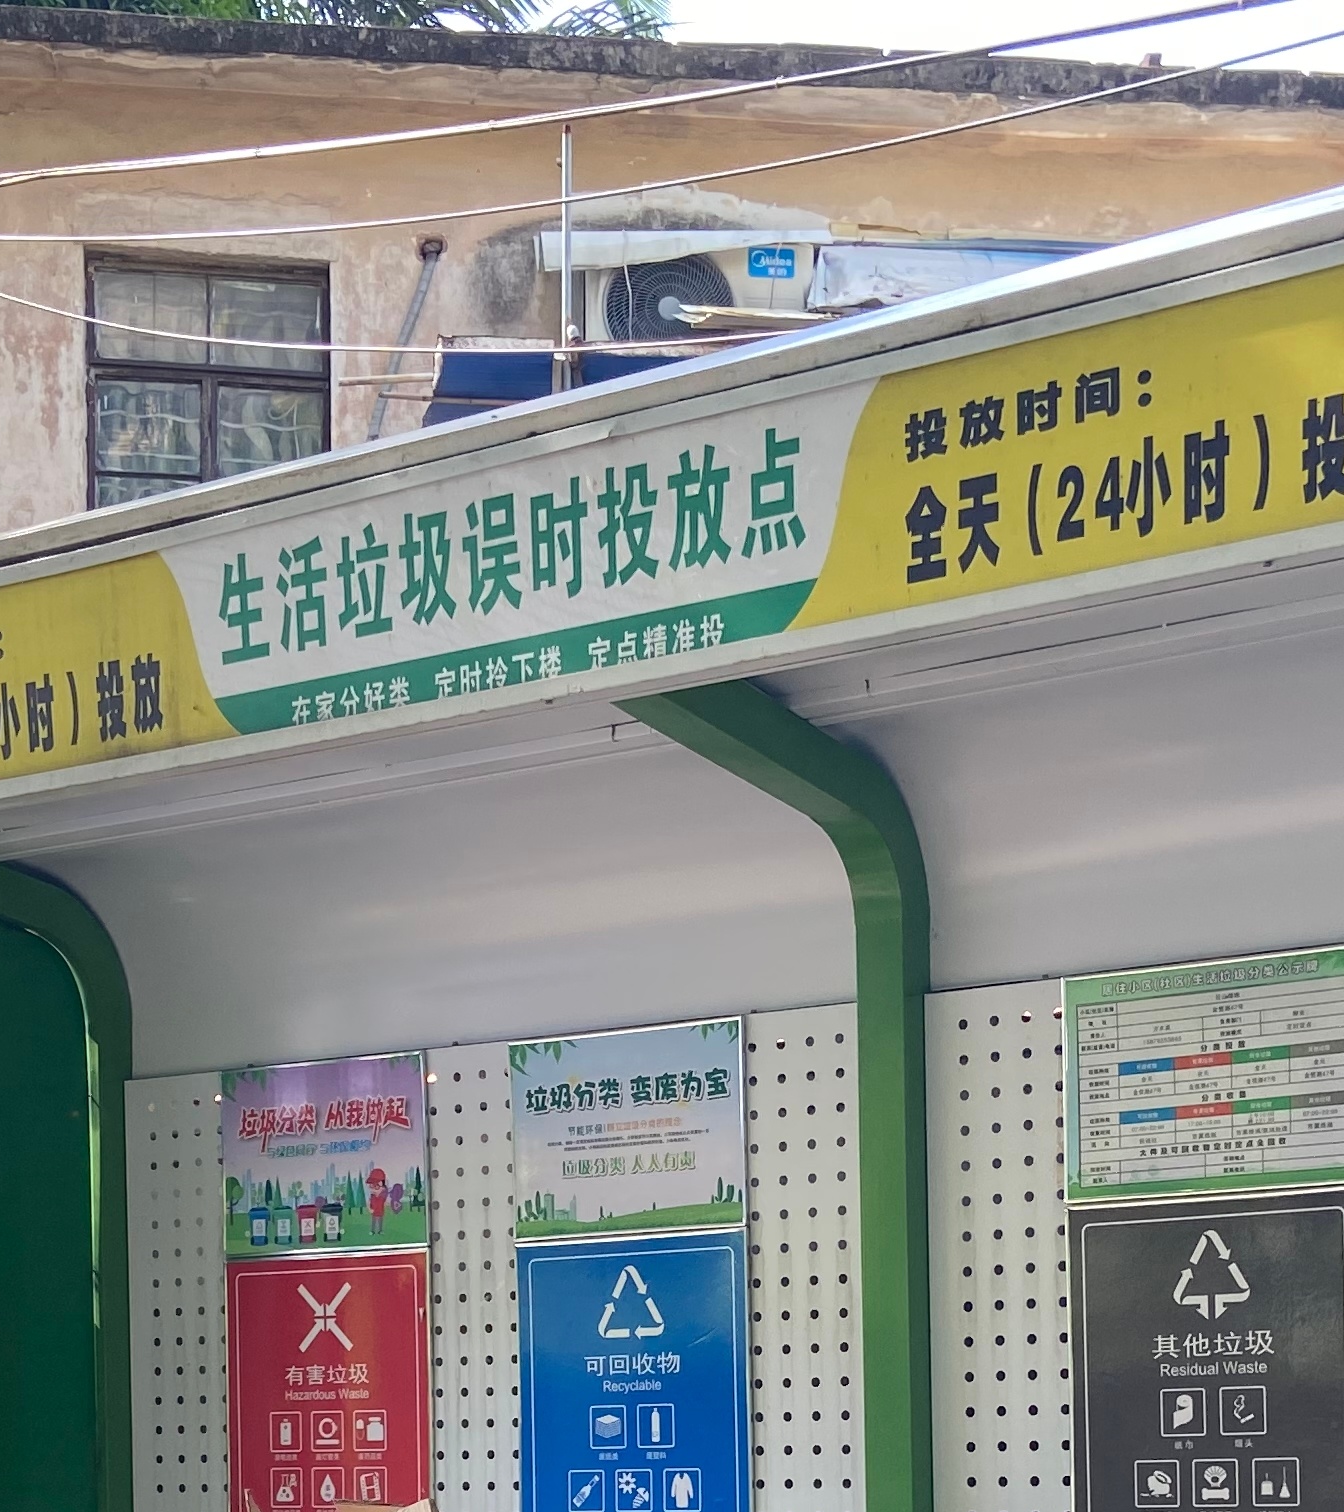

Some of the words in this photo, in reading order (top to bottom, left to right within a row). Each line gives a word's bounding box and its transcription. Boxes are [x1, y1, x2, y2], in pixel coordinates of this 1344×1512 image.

[904, 366, 1154, 463] 投放时间：
[218, 427, 808, 665] 生活垃圾误时投放点
[525, 1077, 623, 1114] 垃圾分类
[629, 1067, 730, 1104] 变废为宝
[238, 1104, 317, 1153] 垃圾分类
[324, 1095, 411, 1143] 从我做起
[1152, 1330, 1276, 1360] 其他垃圾
[285, 1363, 370, 1386] 有害垃圾
[583, 1351, 682, 1377] 可回收物
[1159, 1362, 1219, 1378] Residual
[1222, 1360, 1269, 1375] Waste
[284, 1389, 336, 1401] Hazardous
[338, 1388, 370, 1400] Waste
[603, 1380, 662, 1395] Recyclable
